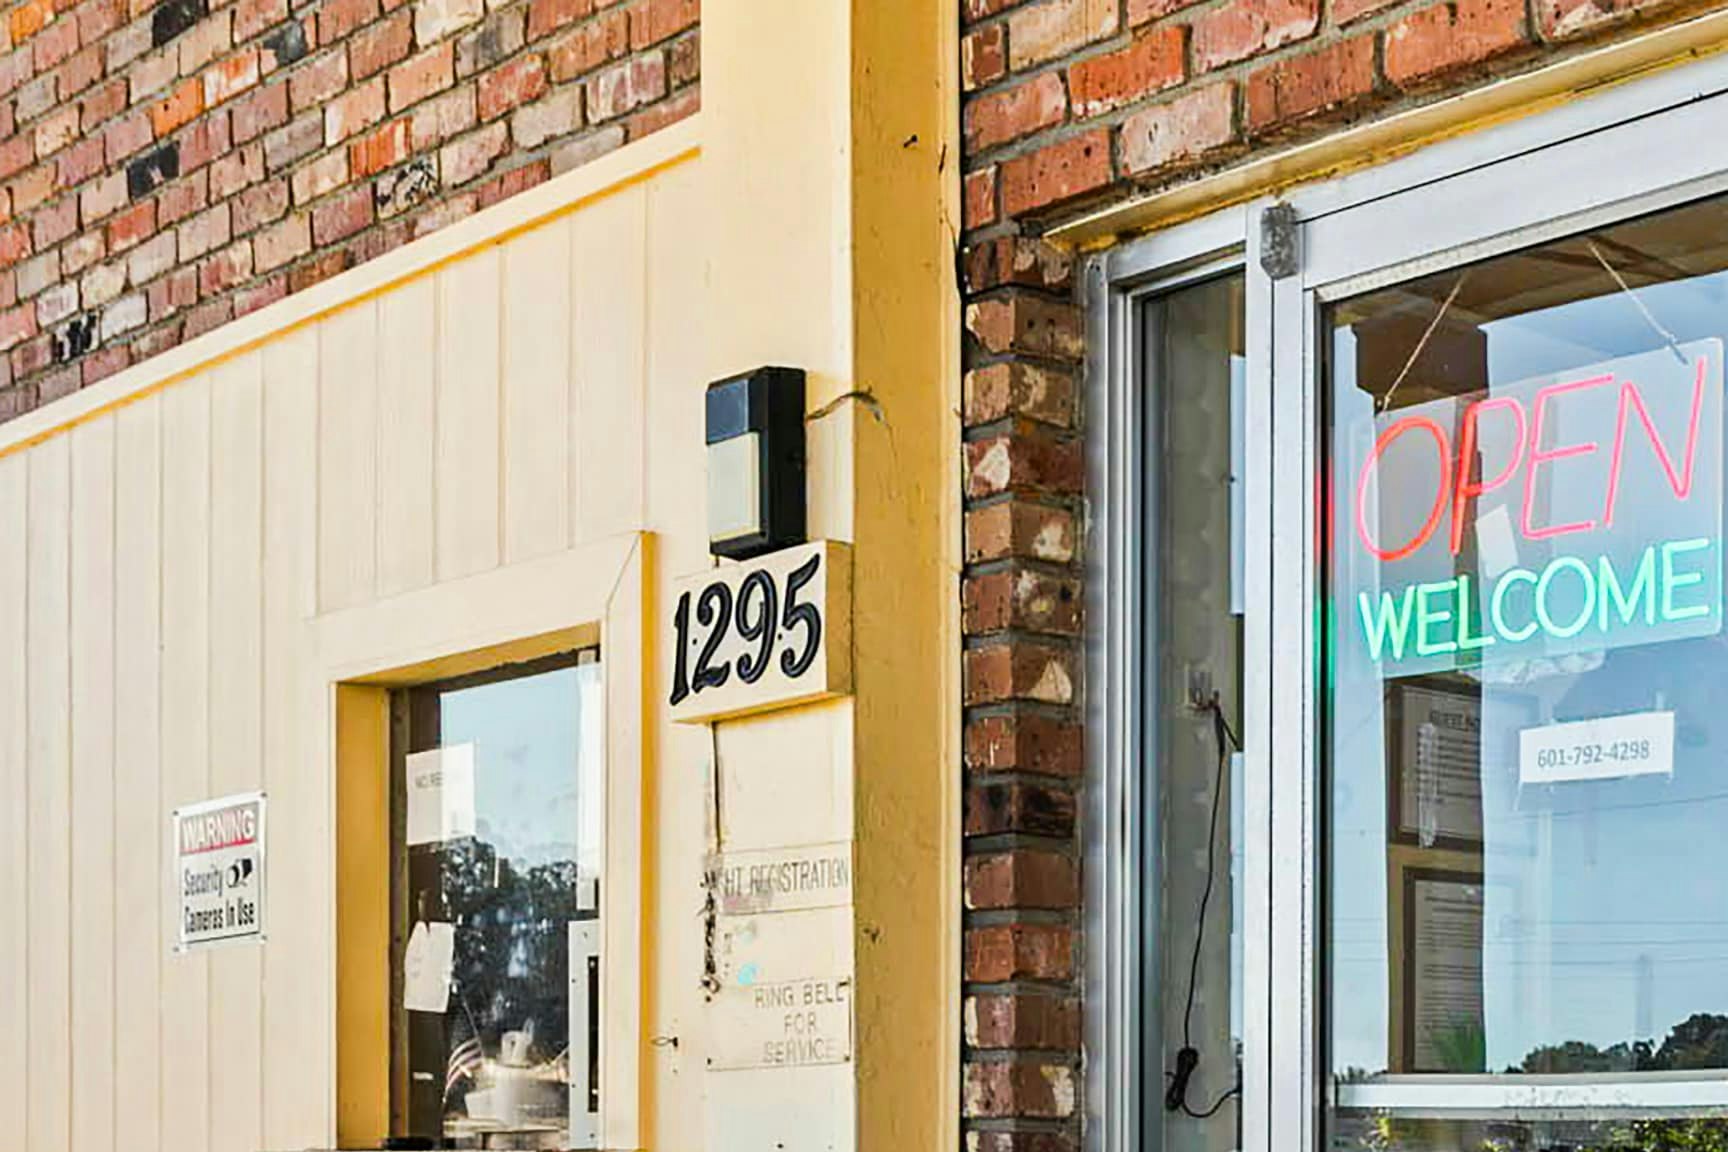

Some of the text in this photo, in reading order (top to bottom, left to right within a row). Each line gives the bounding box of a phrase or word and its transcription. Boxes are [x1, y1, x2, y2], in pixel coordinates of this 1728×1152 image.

[1356, 355, 1708, 561] OPEN
[1357, 537, 1711, 661] WELCOME
[669, 552, 822, 706] 1295
[1537, 739, 1650, 768] 601-792-4298
[182, 809, 255, 850] WARNING
[184, 865, 222, 898] Security
[750, 857, 849, 897] REGISTRATION
[184, 897, 255, 934] Cameras In Use
[755, 985, 794, 1008] RING
[784, 1011, 817, 1034] FOR
[763, 1037, 836, 1063] SERVICE
